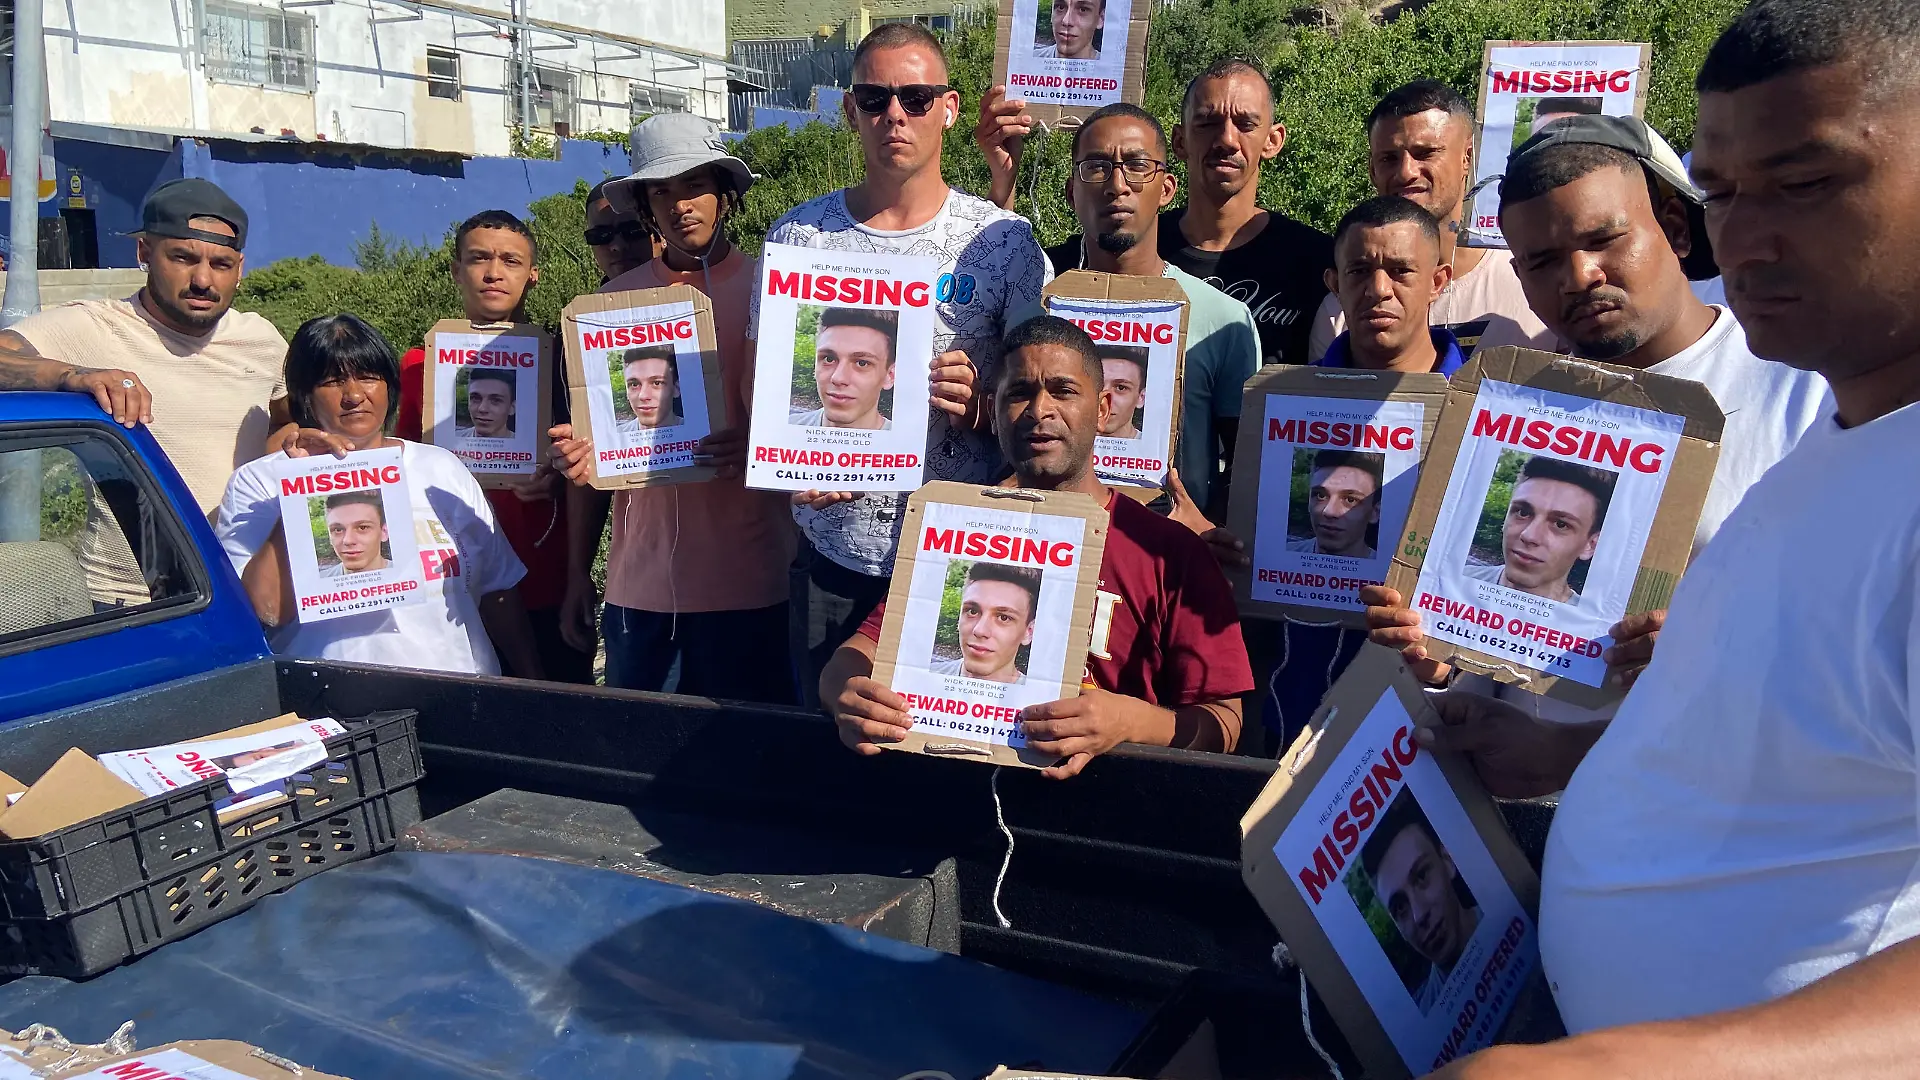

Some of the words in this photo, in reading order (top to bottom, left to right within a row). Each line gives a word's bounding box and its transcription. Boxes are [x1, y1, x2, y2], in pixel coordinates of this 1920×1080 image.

[1011, 74, 1062, 88] REWARD
[1065, 77, 1117, 90] OFFERED
[1492, 70, 1630, 93] MISSING
[1024, 90, 1047, 98] CALL:
[812, 263, 831, 272] HELP
[844, 266, 860, 274] FIND
[862, 267, 873, 275] MY
[768, 269, 930, 308] MISSING
[583, 320, 693, 350] MISSING
[439, 349, 534, 368] MISSING
[1528, 406, 1550, 415] HELP
[1551, 410, 1563, 419] ME
[1565, 413, 1584, 423] FIND
[1586, 417, 1600, 426] MY
[1601, 420, 1620, 430] SON
[829, 430, 873, 438] FRISCHKE
[1268, 417, 1415, 450] MISSING
[1472, 408, 1665, 474] MISSING
[450, 450, 482, 460] WARD
[485, 452, 532, 461] OFFERED
[600, 445, 652, 462] REWARD
[654, 440, 700, 454] OFFERE
[755, 446, 834, 466] REWARD
[838, 453, 918, 468] OFFERED
[1102, 456, 1162, 471] OFFERED
[281, 465, 401, 497] MISSING
[776, 469, 813, 481] CALL:
[816, 473, 840, 481] 062
[843, 473, 863, 482] 291
[867, 473, 896, 482] 4713
[996, 524, 1012, 532] FIND
[923, 527, 1075, 567] MISSING
[1321, 558, 1360, 566] FRISCHKE
[1258, 568, 1326, 589] REWARD
[301, 590, 358, 608] REWARD
[361, 580, 418, 598] OFFERED
[319, 606, 347, 615] CALL:
[348, 602, 366, 610] 062
[385, 595, 405, 604] 4713
[1275, 588, 1308, 598] CALL:
[1310, 592, 1331, 602] 062
[1334, 594, 1351, 603] 291
[1478, 584, 1502, 596] NICK
[1505, 591, 1555, 610] FRISCHKE
[1478, 593, 1491, 601] 22
[1494, 597, 1525, 611] YEARS
[1529, 607, 1550, 618] OLD
[1417, 592, 1505, 630] REWARD
[1507, 619, 1603, 659] OFFERED
[1436, 621, 1476, 641] CALL:
[1480, 634, 1506, 649] 062
[1510, 643, 1534, 658] 291
[1537, 651, 1571, 669] 4713
[958, 687, 985, 696] YEARS
[966, 681, 1008, 692] FRISCHKE
[971, 703, 1024, 724] OFFER
[913, 716, 946, 728] CALL:
[950, 721, 972, 731] 062
[975, 725, 995, 735] 291
[998, 728, 1025, 739] 4713
[1318, 803, 1333, 826] HELP
[1332, 793, 1343, 806] ME
[1341, 774, 1354, 794] FIND
[1353, 765, 1362, 776] MY
[1362, 747, 1375, 764] SON
[1299, 725, 1419, 905] MISSING
[1432, 1000, 1478, 1070] EWARD
[1475, 915, 1526, 1003] OFFERED
